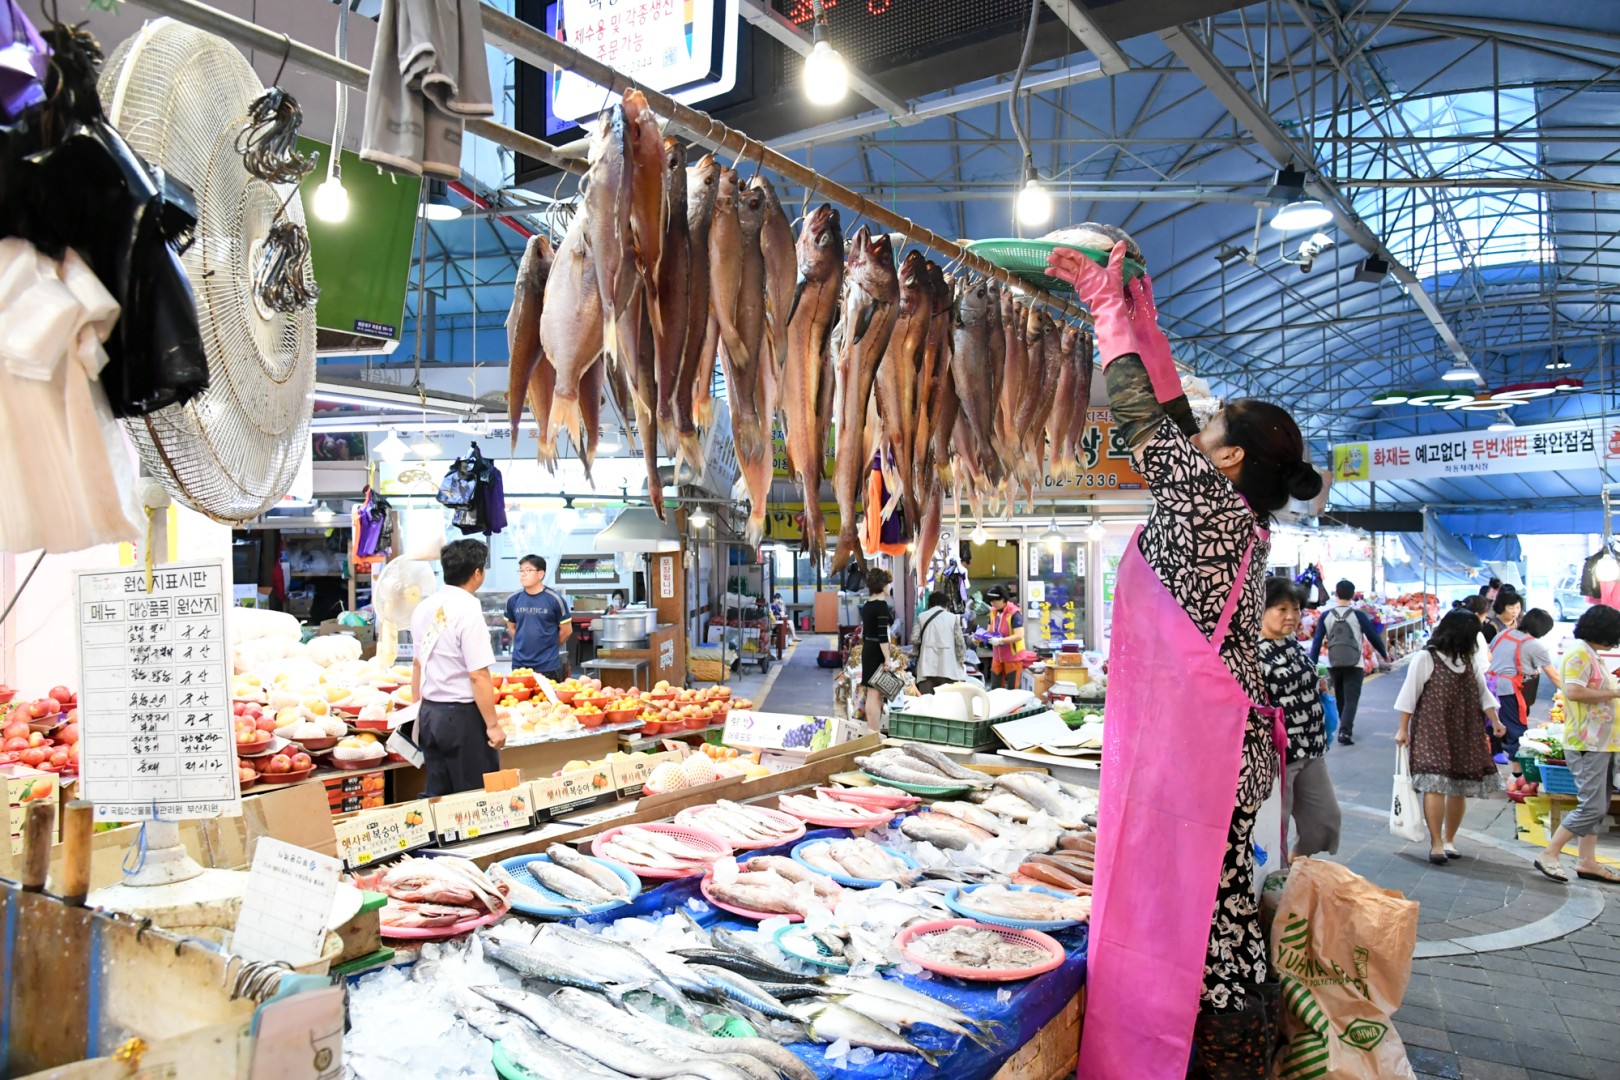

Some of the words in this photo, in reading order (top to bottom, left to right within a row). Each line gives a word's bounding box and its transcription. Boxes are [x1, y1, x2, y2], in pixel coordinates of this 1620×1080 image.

[575, 19, 606, 44] 제수용
[610, 13, 621, 34] 및
[625, 0, 674, 27] 각종생선
[596, 32, 644, 61] 주문가능
[1374, 447, 1410, 467] 화재는
[1415, 441, 1467, 464] 예고없다
[1472, 435, 1528, 459] 두번세번
[1533, 429, 1595, 456] 확인점검
[91, 604, 117, 621] 메뉴
[129, 600, 170, 618] 대상품목
[177, 597, 217, 616] 원산지
[570, 783, 591, 796] 복숭아
[481, 804, 504, 818] 복숭아
[341, 831, 372, 851] 햇사레
[372, 822, 400, 840] 복숭아
